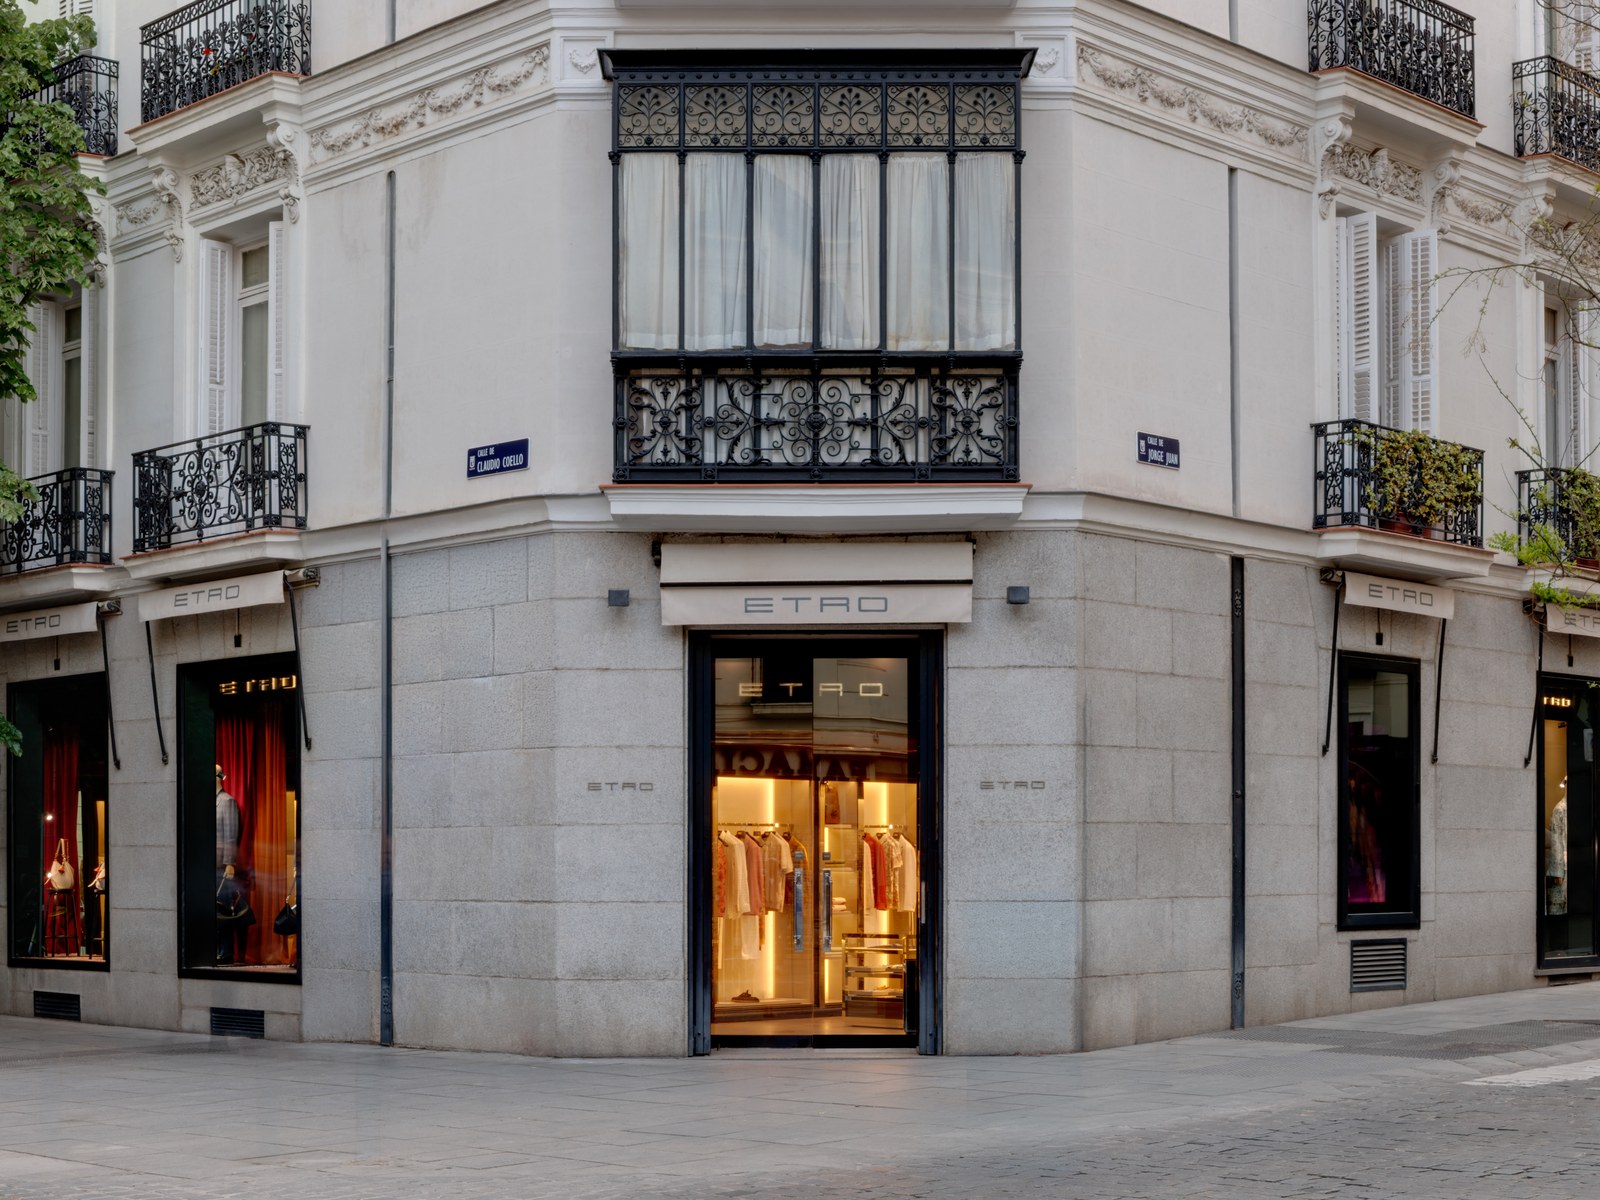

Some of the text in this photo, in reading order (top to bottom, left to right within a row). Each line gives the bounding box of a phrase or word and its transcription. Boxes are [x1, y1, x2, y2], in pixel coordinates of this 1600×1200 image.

[1158, 438, 1164, 447] DE
[477, 446, 495, 457] CALLE DE
[1147, 449, 1178, 466] JORGE JUAN
[477, 453, 524, 472] CLAUDIO COELLO
[174, 585, 240, 607] ETRO
[1368, 583, 1434, 607] ETRO
[744, 596, 888, 613] ETRO
[6, 614, 61, 633] ETRO
[739, 682, 884, 697] ETRO
[587, 782, 654, 791] ETRO
[980, 781, 1046, 790] ETRO
